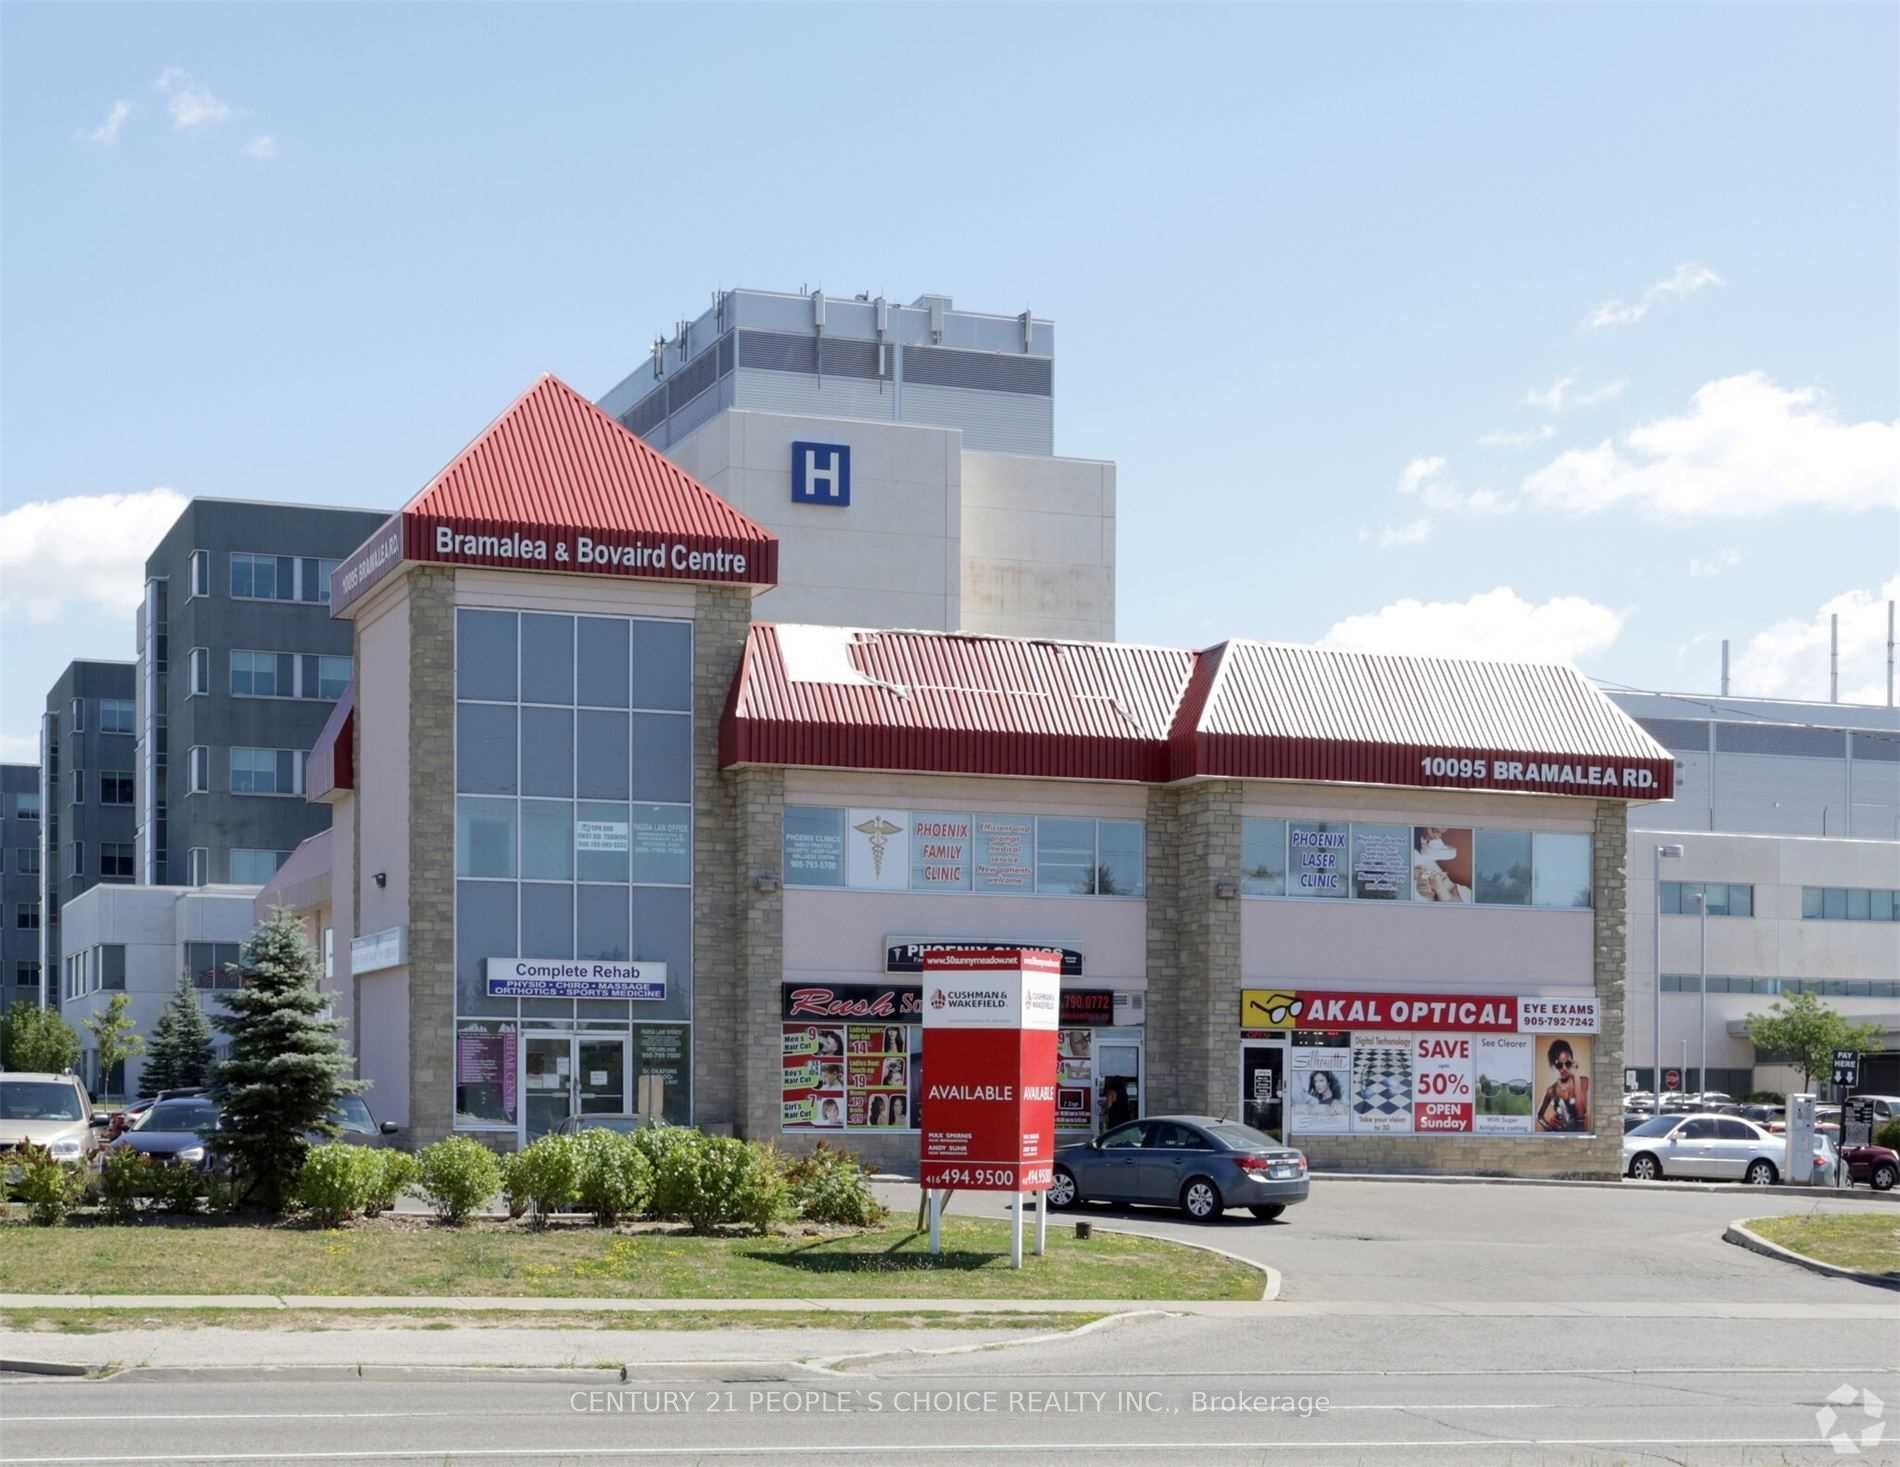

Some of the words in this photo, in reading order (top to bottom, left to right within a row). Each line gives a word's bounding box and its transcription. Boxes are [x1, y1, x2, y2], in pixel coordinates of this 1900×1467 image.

[806, 450, 839, 497] H
[436, 527, 546, 560] Bramalea
[555, 542, 569, 561] &
[577, 537, 665, 568] Bovaird
[671, 544, 746, 573] Centre
[1422, 757, 1486, 779] 10095
[1493, 761, 1618, 786] BRAMALEA
[1623, 768, 1658, 788] RD.
[916, 823, 968, 838] PHOENIX
[1293, 832, 1345, 848] PHOENIX
[923, 844, 962, 859] FAMILY
[1303, 854, 1336, 868] LASER
[924, 866, 961, 880] CLINIC
[1300, 874, 1337, 888] CLINIC
[515, 963, 588, 979] Complete
[593, 965, 640, 978] Rehab
[494, 987, 557, 995] ORTHOTICS
[566, 988, 609, 996] SPORTS
[611, 989, 662, 997] MEDICINE
[947, 991, 999, 999] CUSHMAN
[1000, 991, 1007, 999] &
[790, 988, 896, 1017] Rush
[948, 1000, 1005, 1008] WAKEFIELD
[1524, 1004, 1547, 1014] EYE
[1552, 1004, 1594, 1015] EXAMS
[1307, 999, 1382, 1022] AKAL
[1390, 1001, 1512, 1025] OPTICAL
[1524, 1016, 1594, 1027] 905-792-7242
[808, 1027, 817, 1040] 9
[1354, 1036, 1375, 1047] Digital
[1376, 1036, 1411, 1047] Technology
[1481, 1039, 1496, 1047] See
[1497, 1039, 1527, 1048] Clearer
[1418, 1040, 1469, 1058] SAVE
[1834, 1060, 1856, 1068] HERE
[1418, 1073, 1470, 1095] 50%
[928, 1085, 1013, 1100] AVAILABLE
[1023, 1086, 1055, 1100] AVAILABLE
[1426, 1104, 1461, 1115] OPEN
[1420, 1116, 1467, 1131] Sunday
[941, 1169, 1013, 1185] 494.9500
